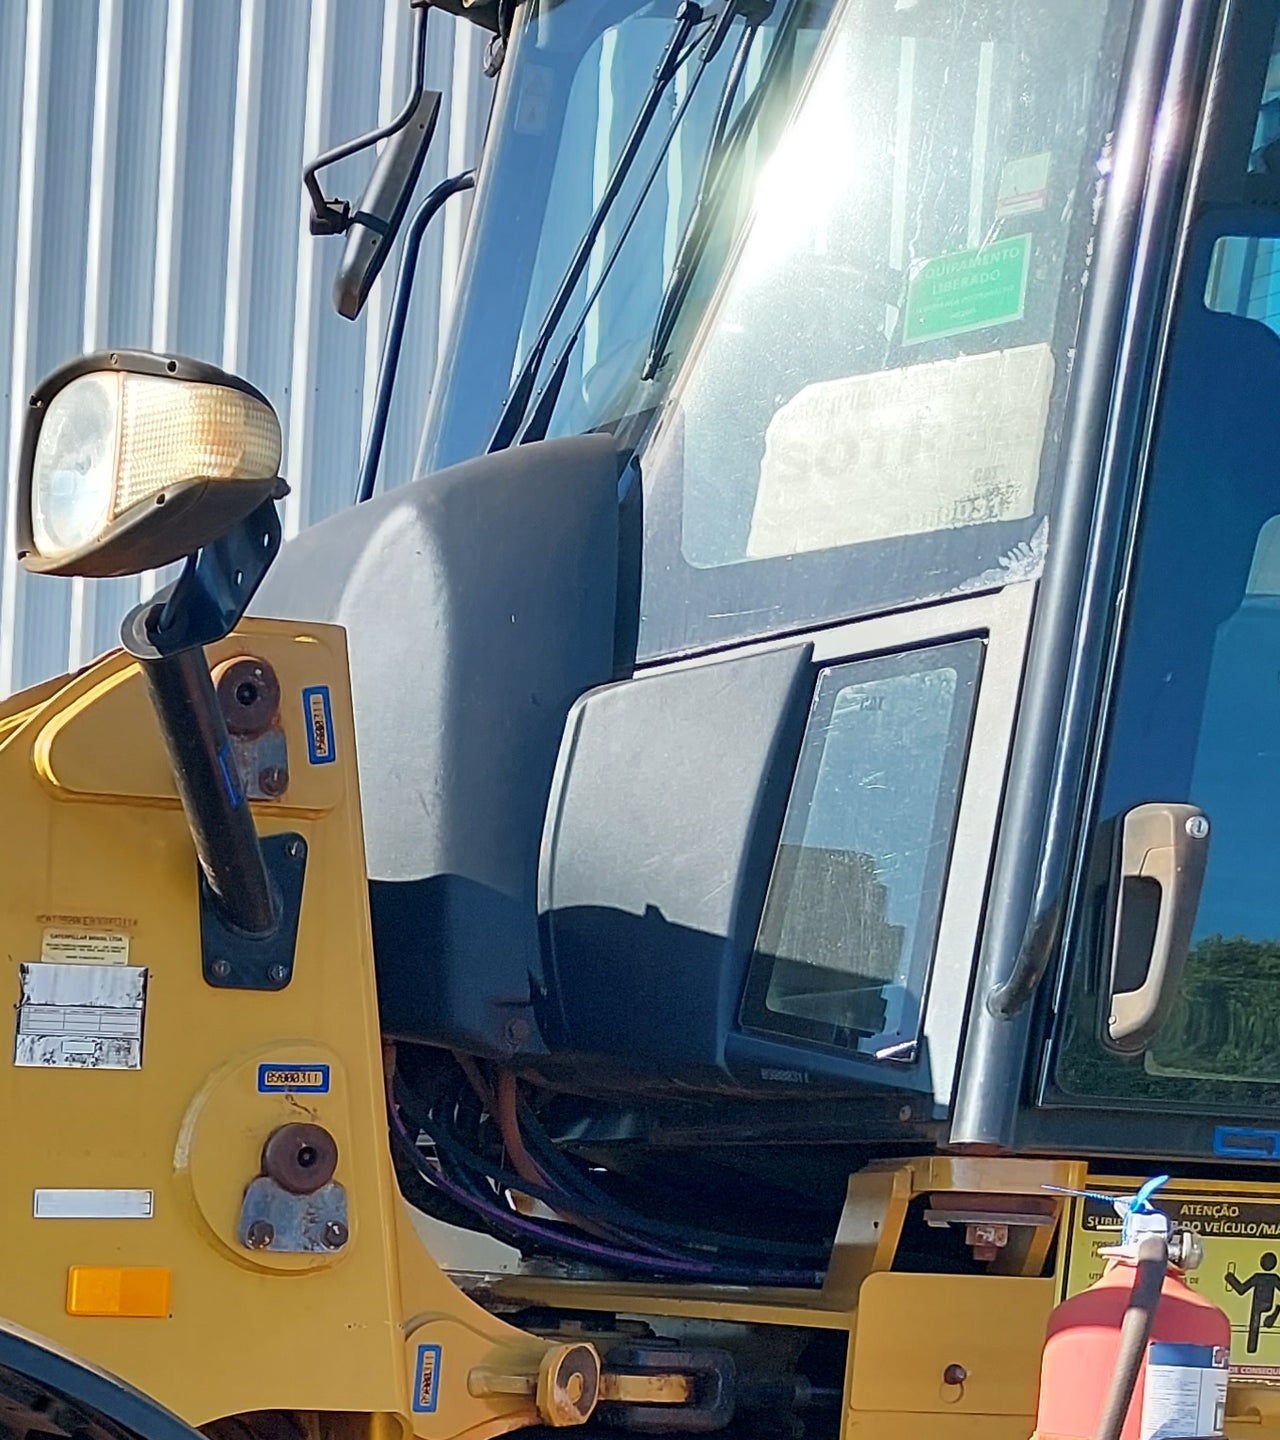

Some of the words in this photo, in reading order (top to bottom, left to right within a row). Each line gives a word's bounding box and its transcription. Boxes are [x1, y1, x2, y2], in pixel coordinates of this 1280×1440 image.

[917, 247, 1020, 284] QUIPAMENTO
[933, 269, 1001, 295] LIBERADO
[1181, 1204, 1240, 1219] ATENÇÃO
